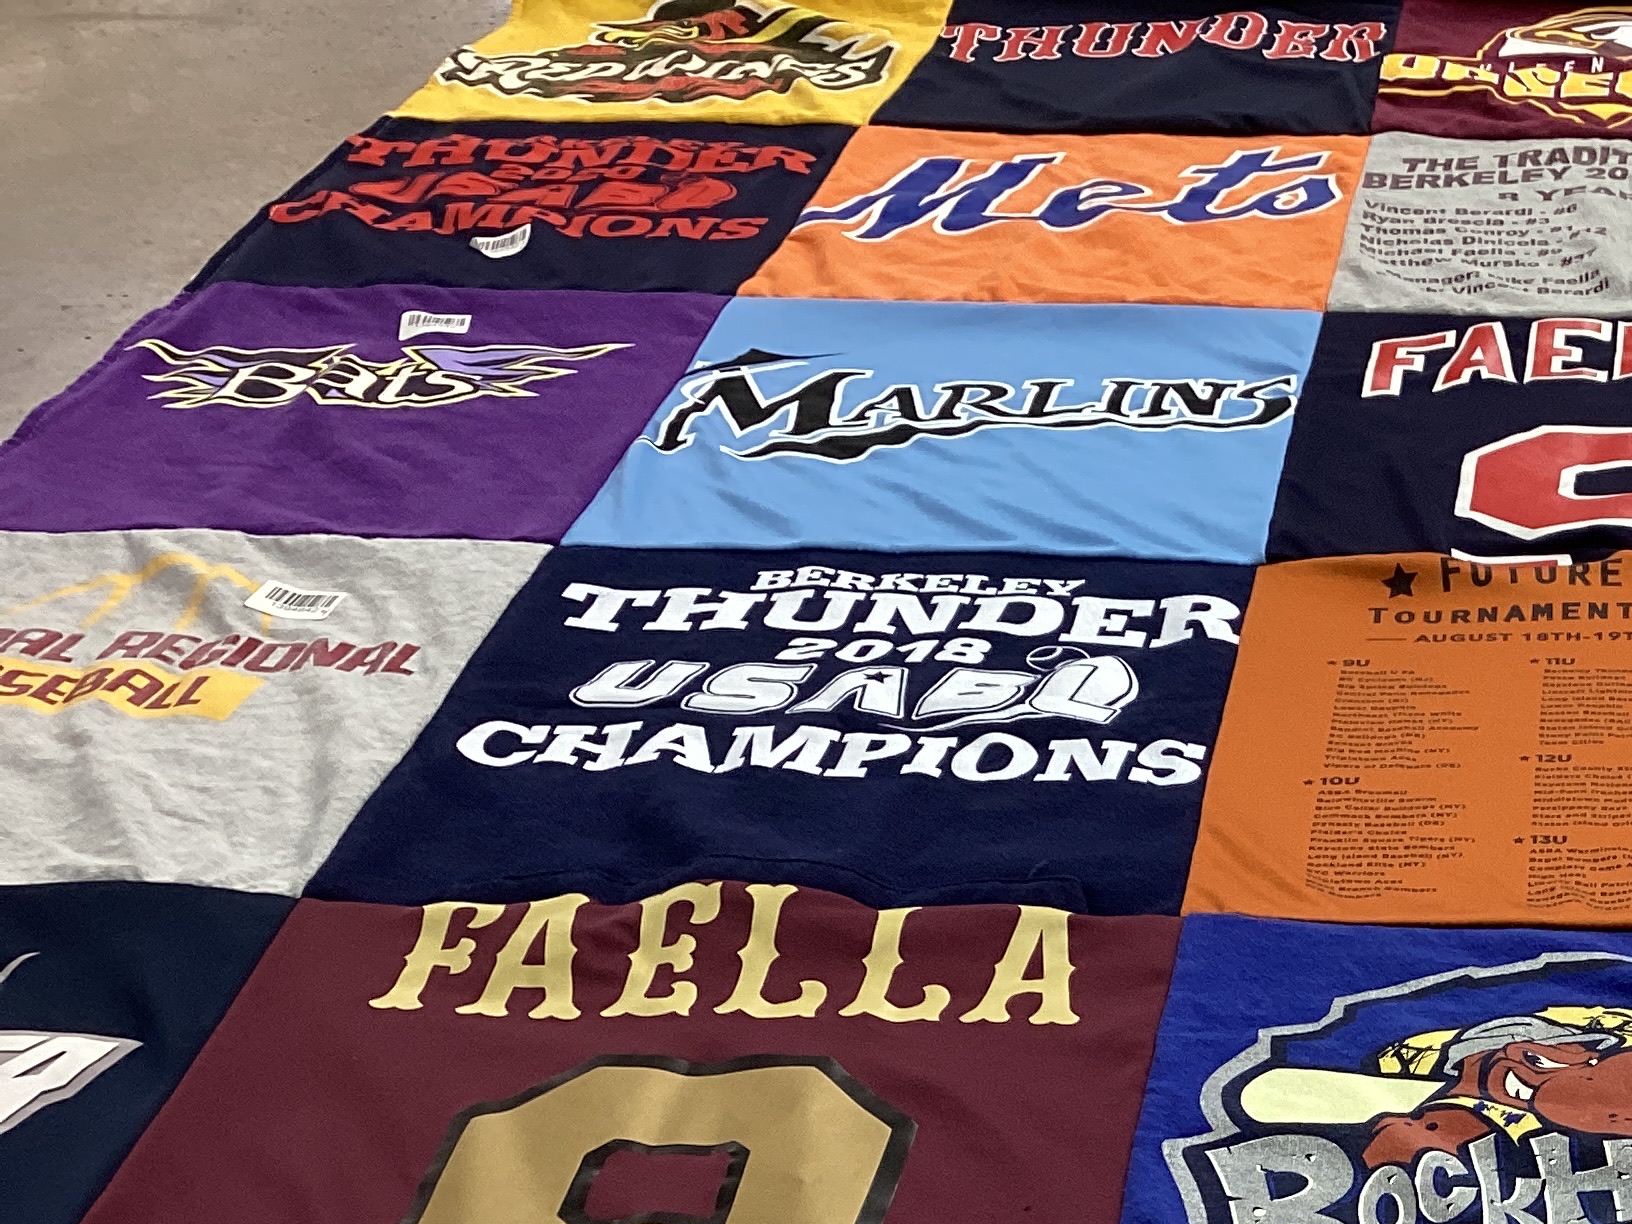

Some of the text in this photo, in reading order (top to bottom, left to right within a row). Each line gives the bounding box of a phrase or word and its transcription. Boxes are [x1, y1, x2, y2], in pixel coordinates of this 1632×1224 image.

[941, 11, 1387, 63] THUNDER
[346, 134, 817, 174] THUNDER
[1402, 156, 1480, 172] THE
[790, 146, 1344, 242] Mets
[1362, 166, 1572, 190] BERKELEY
[749, 566, 1086, 596] BERKELEY
[561, 583, 1241, 648] THUNDER
[1413, 632, 1513, 643] AUGUST
[95, 629, 422, 678] REGIONAL
[774, 637, 991, 664] 2018
[0, 665, 211, 710] SEBALL
[456, 720, 1207, 787] CHAMPIONS
[368, 882, 1082, 1026] FAELLA
